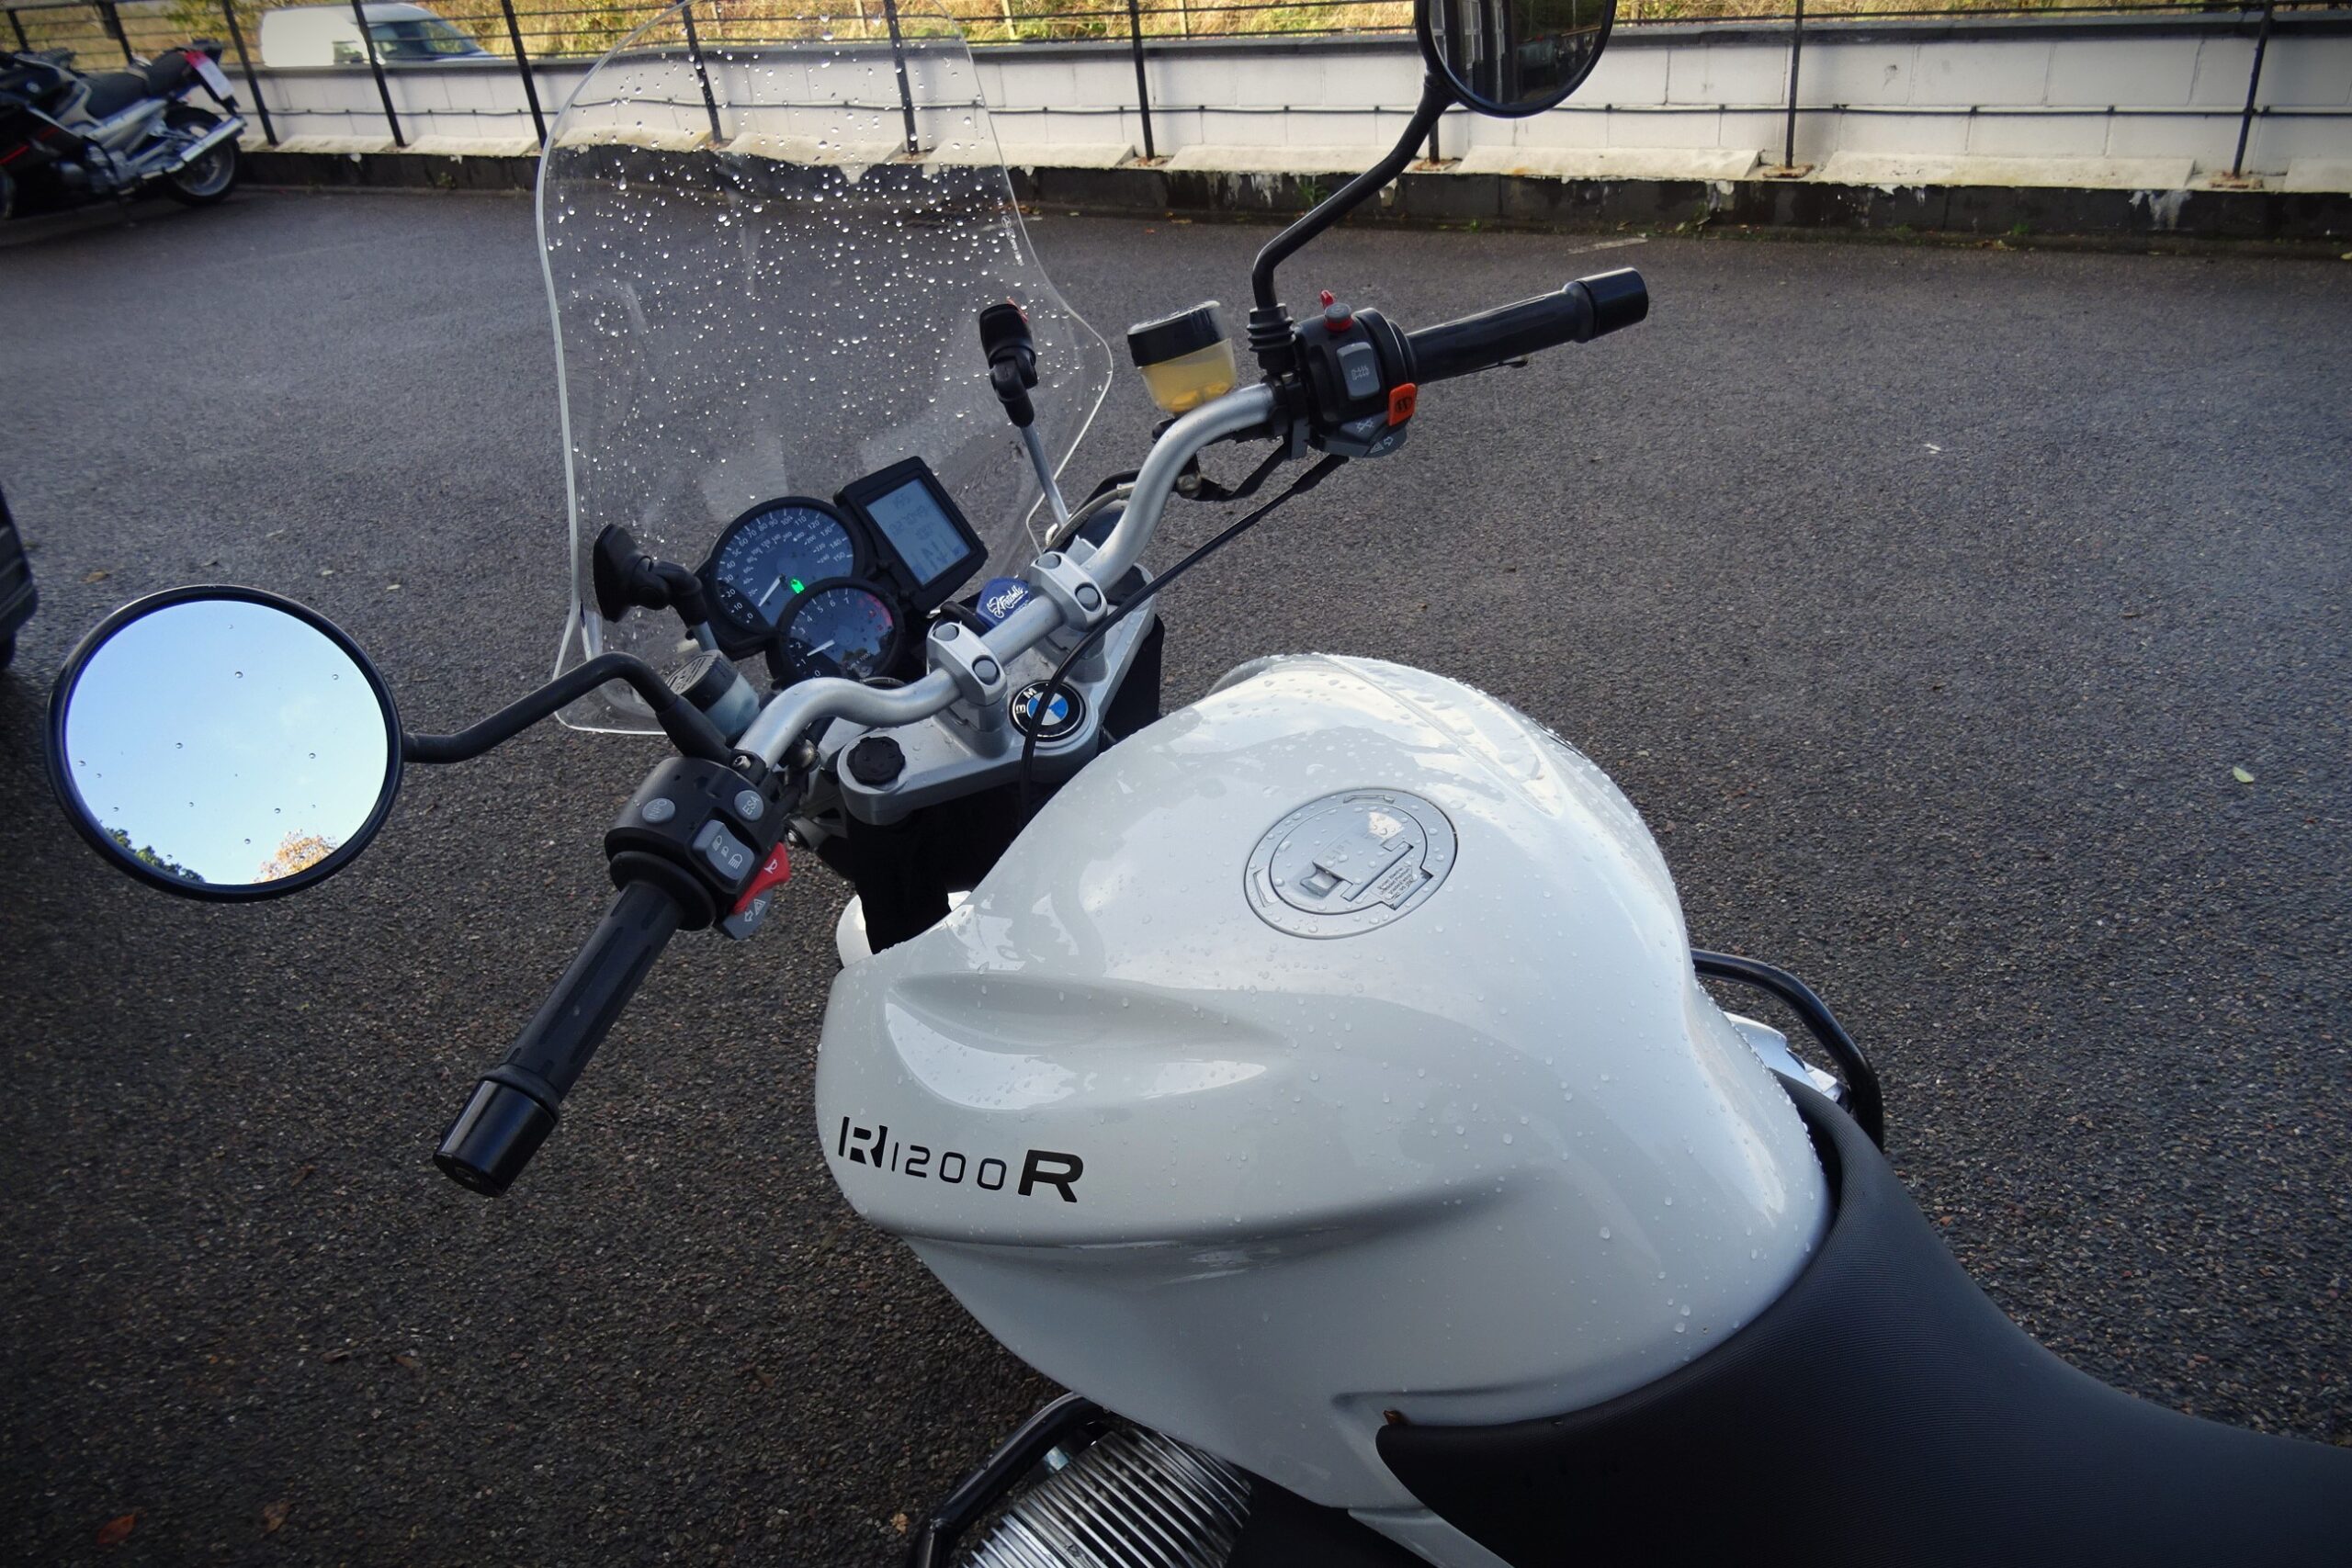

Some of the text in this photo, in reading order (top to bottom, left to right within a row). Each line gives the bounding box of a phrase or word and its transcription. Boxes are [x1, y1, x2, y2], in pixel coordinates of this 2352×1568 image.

[768, 518, 778, 527] 90
[795, 516, 807, 526] 110
[808, 520, 820, 530] 120
[758, 523, 768, 532] 80
[747, 530, 757, 538] 70
[739, 537, 749, 547] 60
[830, 539, 842, 549] 140
[833, 551, 845, 562] 150
[726, 560, 736, 570] 40
[724, 573, 734, 583] 30
[727, 589, 736, 598] 20
[734, 603, 743, 611] 10
[647, 800, 667, 820] INFO
[742, 795, 760, 816] ESA
